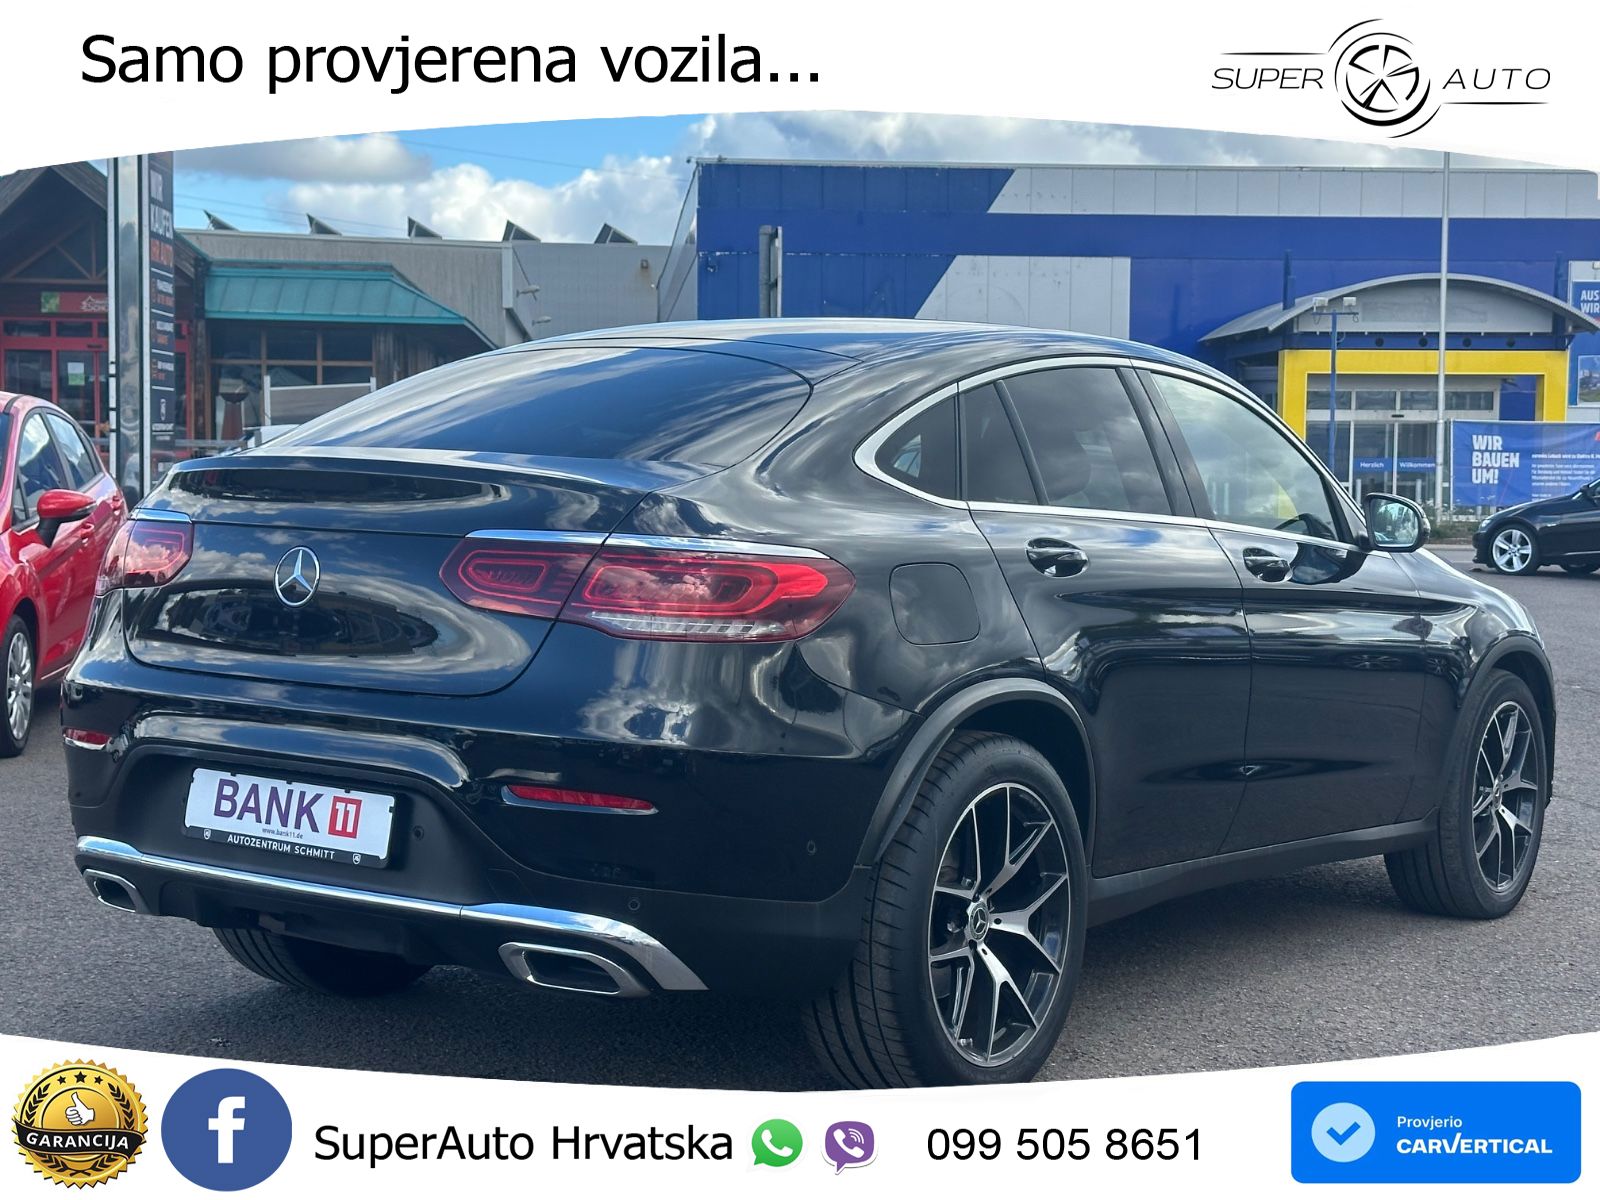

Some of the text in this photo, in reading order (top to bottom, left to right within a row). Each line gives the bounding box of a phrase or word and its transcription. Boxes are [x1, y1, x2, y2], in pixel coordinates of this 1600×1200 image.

[1581, 289, 1600, 301] AUS
[1472, 435, 1503, 451] WIR
[1472, 452, 1520, 468] BAUEN
[1472, 468, 1499, 484] UM!
[213, 778, 358, 833] BANK 11
[262, 827, 304, 840] www.bank11.de
[227, 834, 336, 860] AUTOZENTRUM SCHMITT
